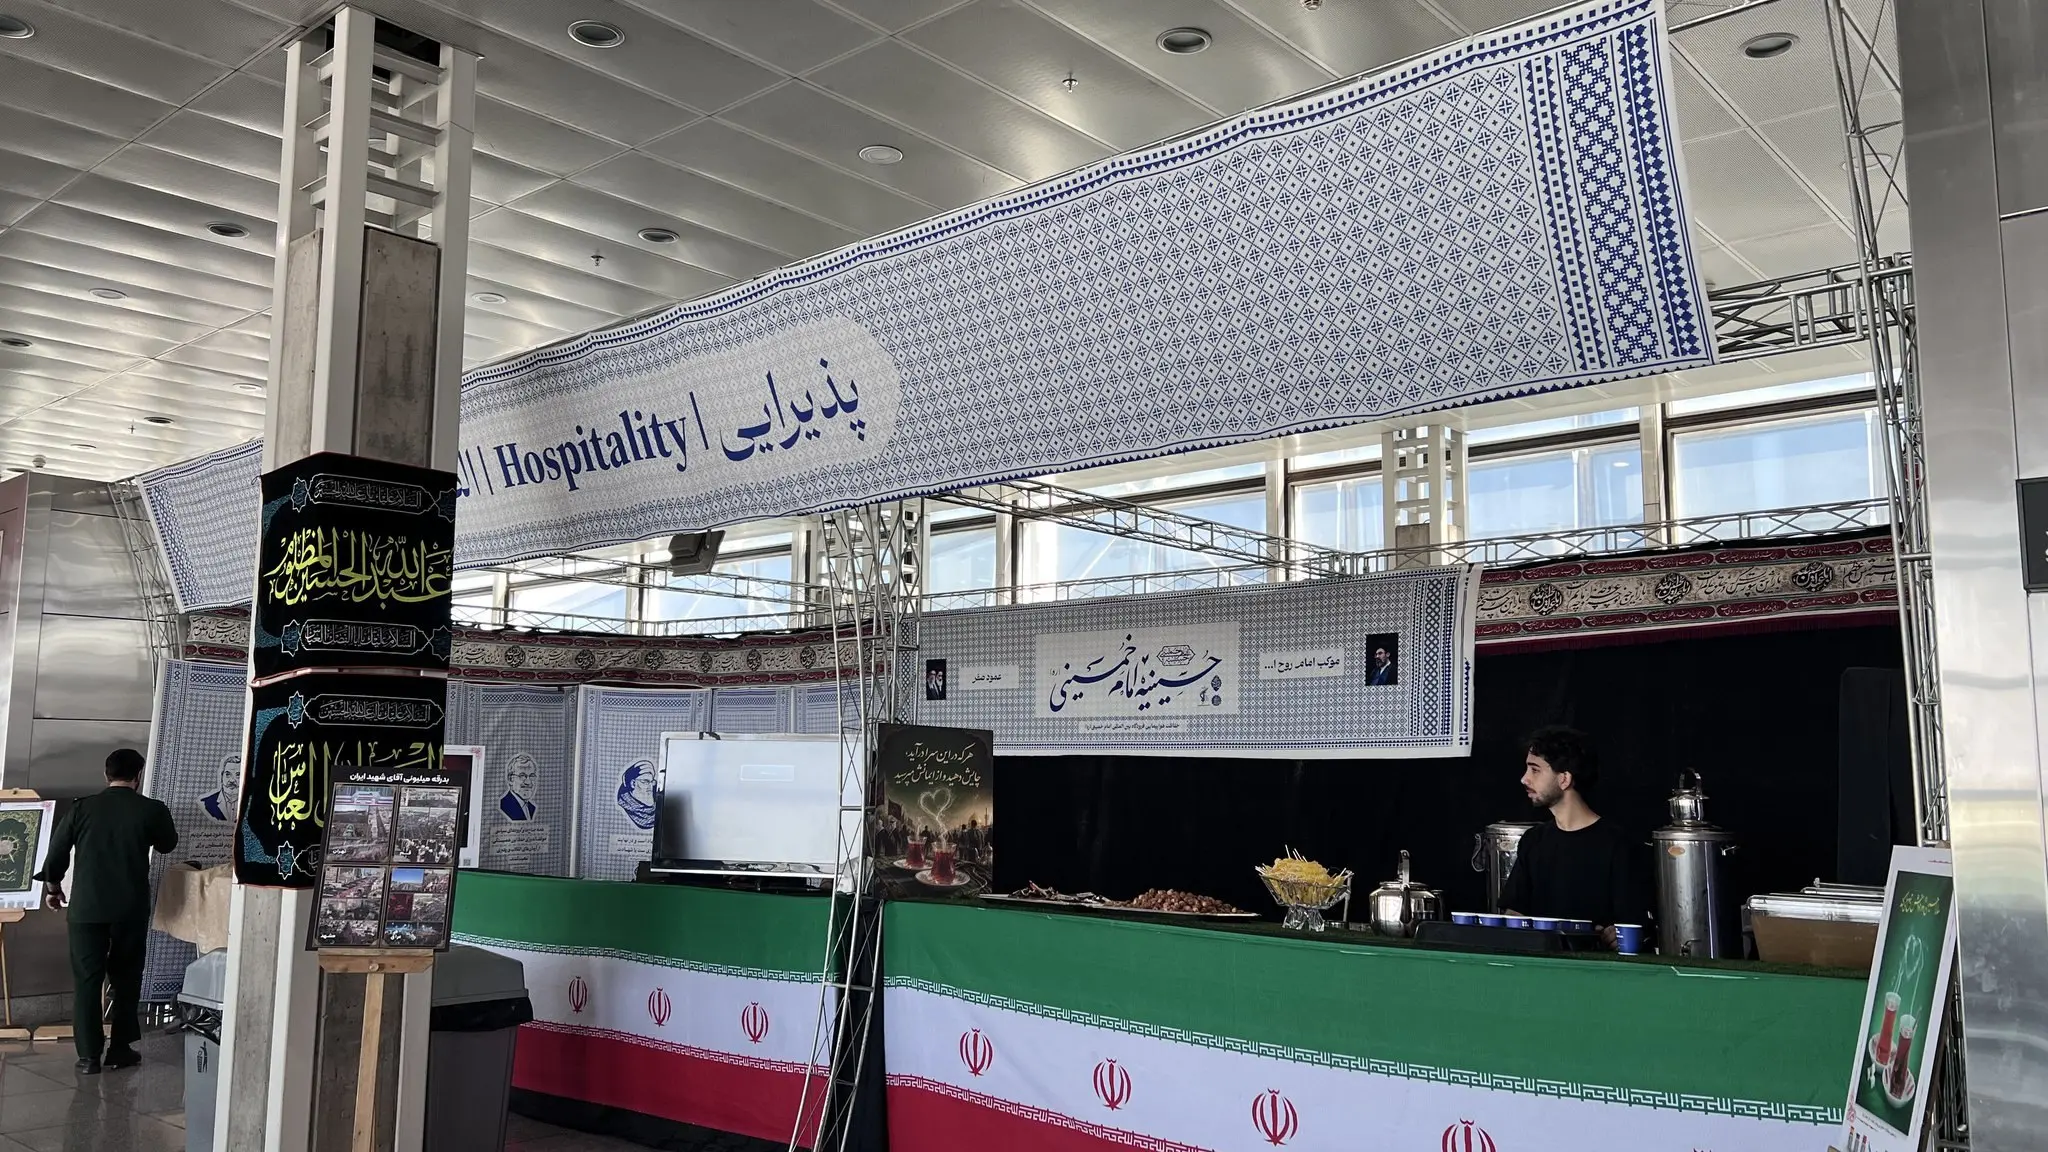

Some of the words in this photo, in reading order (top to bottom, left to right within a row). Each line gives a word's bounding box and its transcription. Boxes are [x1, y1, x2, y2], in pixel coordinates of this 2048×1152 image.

[720, 357, 866, 461] پذیرایی
[493, 410, 687, 492] Hospitality
[1278, 661, 1293, 673] روح
[1317, 656, 1340, 669] موکب
[1049, 633, 1137, 712] خمینی
[1108, 661, 1139, 698] امام
[1134, 653, 1223, 711] حسینیه
[936, 750, 951, 764] این
[349, 772, 366, 781] ایران
[366, 772, 386, 781] شهید
[386, 772, 403, 782] آقای
[403, 774, 431, 784] میلیونی
[431, 774, 450, 784] بدرقه
